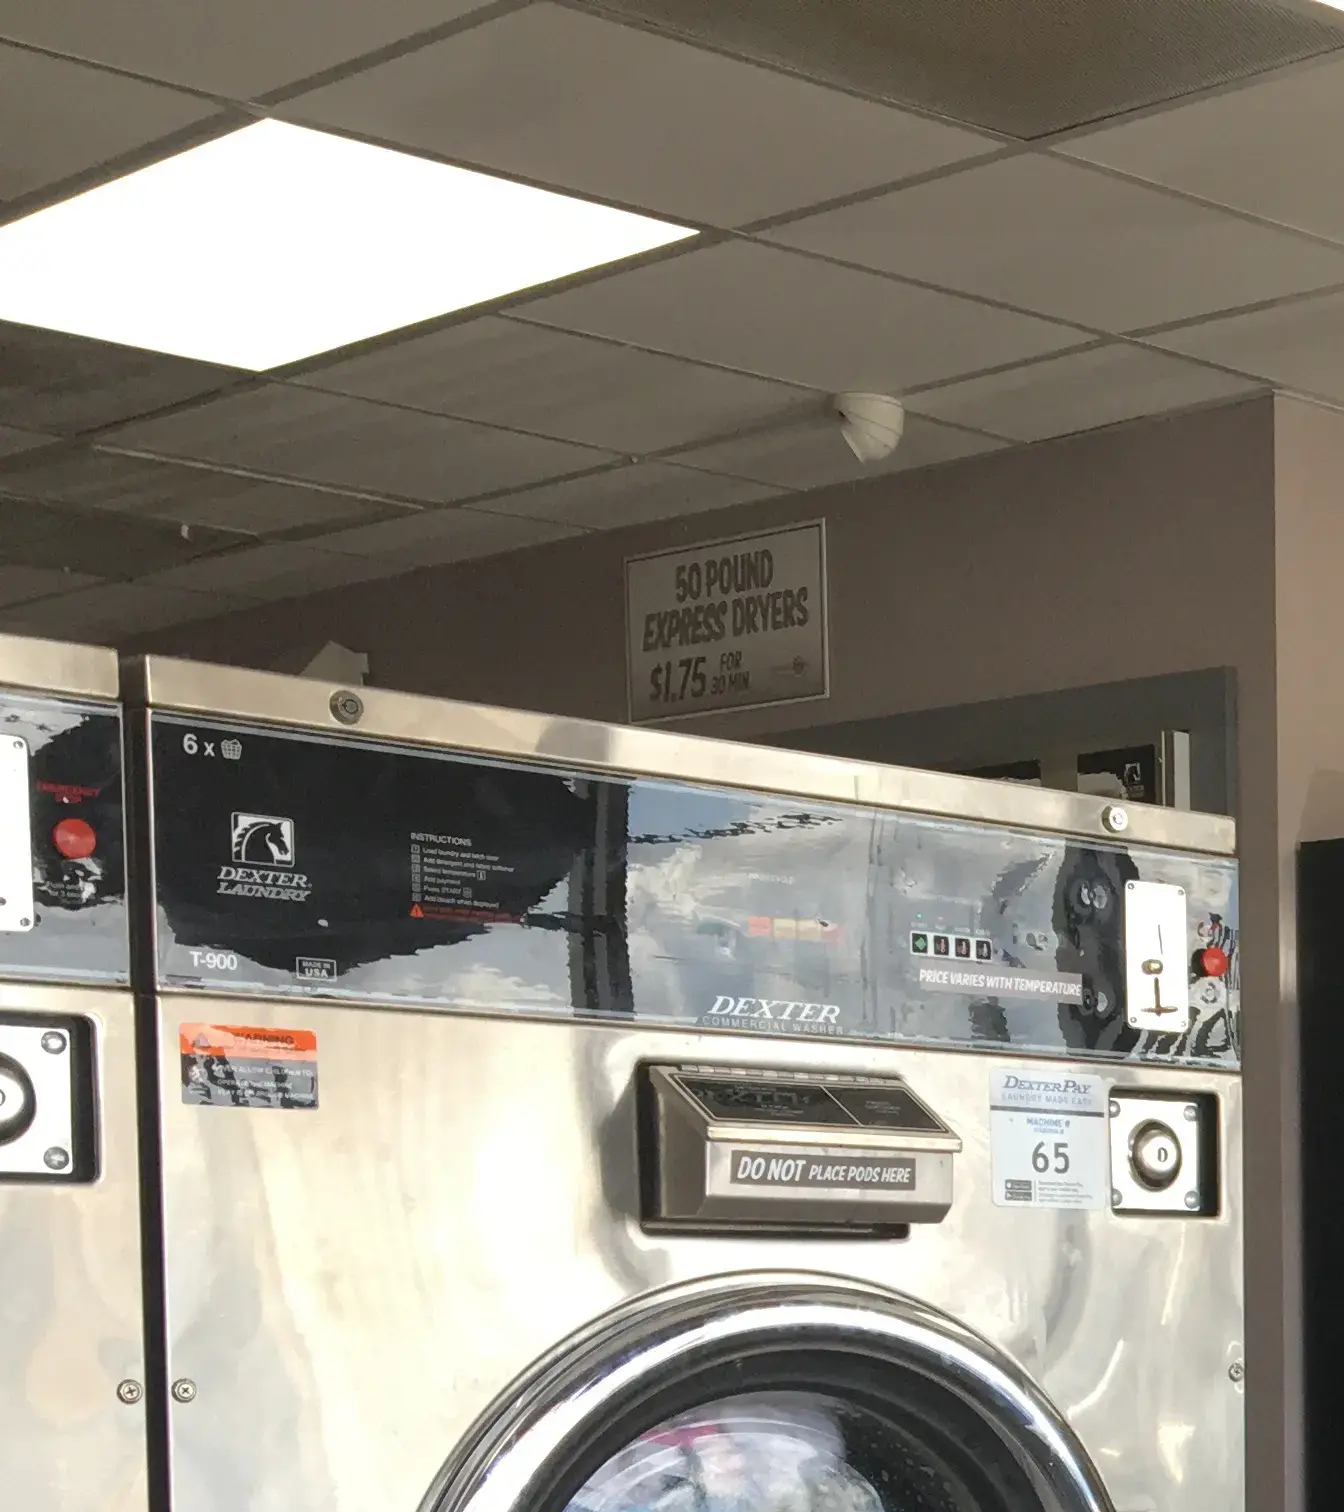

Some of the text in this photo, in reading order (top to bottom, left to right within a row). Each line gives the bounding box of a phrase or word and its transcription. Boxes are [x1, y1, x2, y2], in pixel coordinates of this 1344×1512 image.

[674, 549, 774, 603] 50 POUND
[642, 586, 809, 653] EXPRESS DRYERS
[720, 651, 742, 671] FOR
[649, 656, 707, 702] $1.75
[182, 733, 198, 755] 6
[410, 832, 473, 847] INSTRUCTIONS
[217, 865, 309, 888] DEXTER
[217, 882, 312, 902] LAUNDRY
[189, 951, 238, 970] T-900
[304, 967, 329, 978] USA
[919, 969, 1082, 996] PRICE VARIES WITH TEMPERATURE
[707, 995, 841, 1024] DEXTER
[702, 1016, 844, 1035] COMMERCIAL WASHER
[737, 1156, 912, 1183] DO NOT PLACE PODS HERE
[1031, 1141, 1071, 1175] 65
